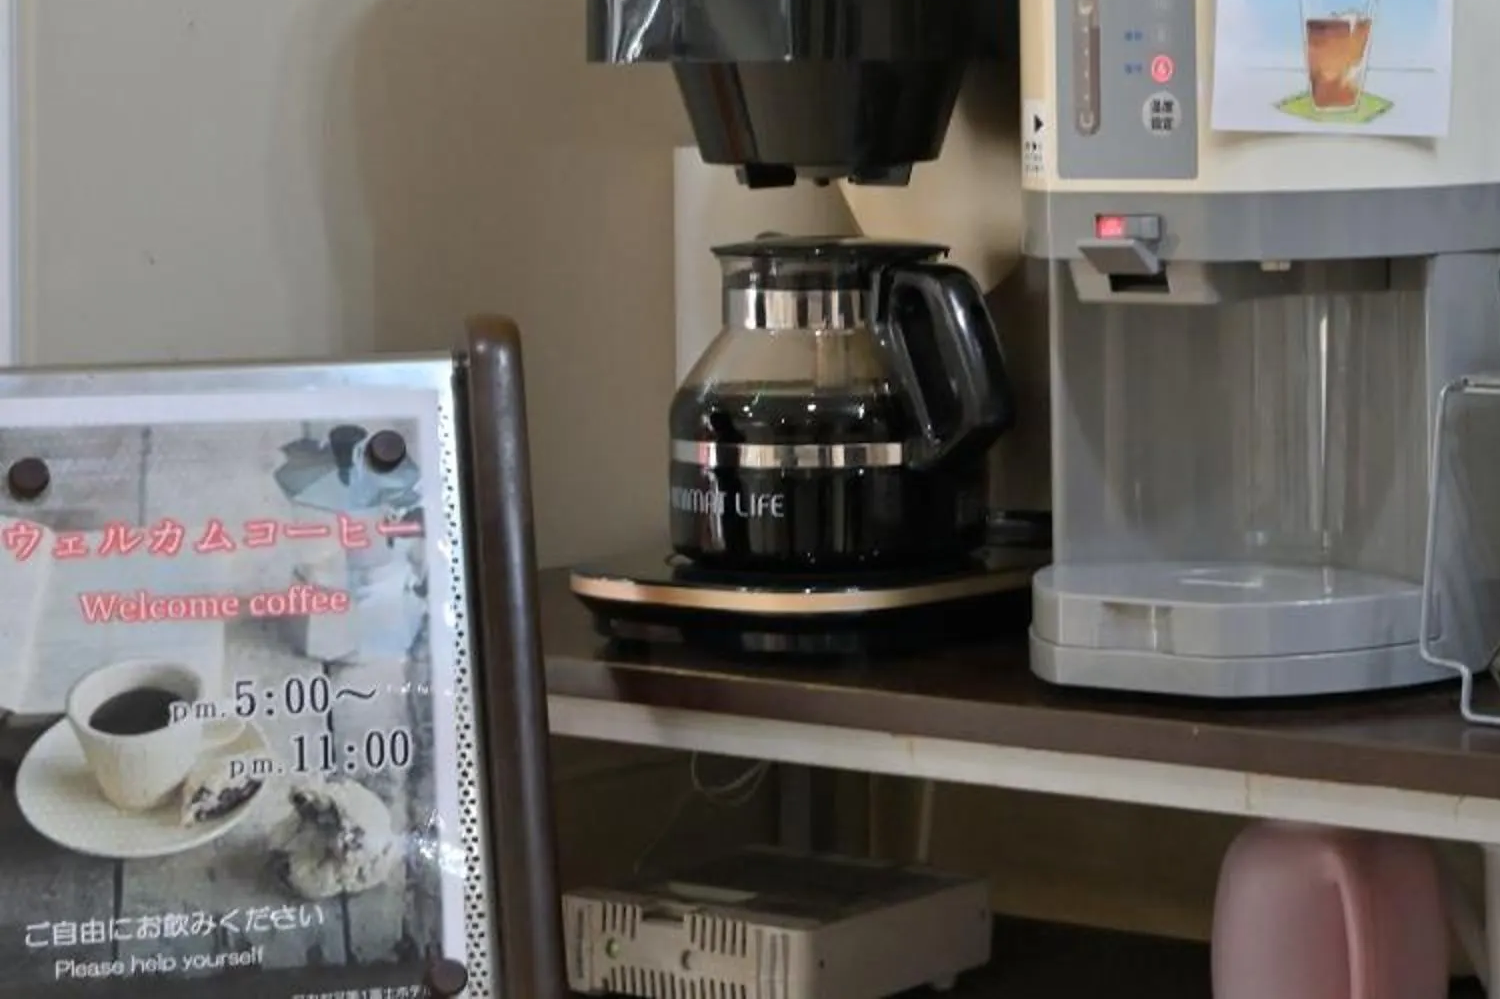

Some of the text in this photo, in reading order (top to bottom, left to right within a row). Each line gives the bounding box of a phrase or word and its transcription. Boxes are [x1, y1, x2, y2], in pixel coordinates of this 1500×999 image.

[735, 492, 785, 518] LIFE
[2, 513, 425, 561] ウェルカムコーヒー
[80, 585, 351, 624] Welcome coffee
[25, 904, 325, 948] ご自由にお飲みください
[55, 945, 264, 981] Please help yourself
